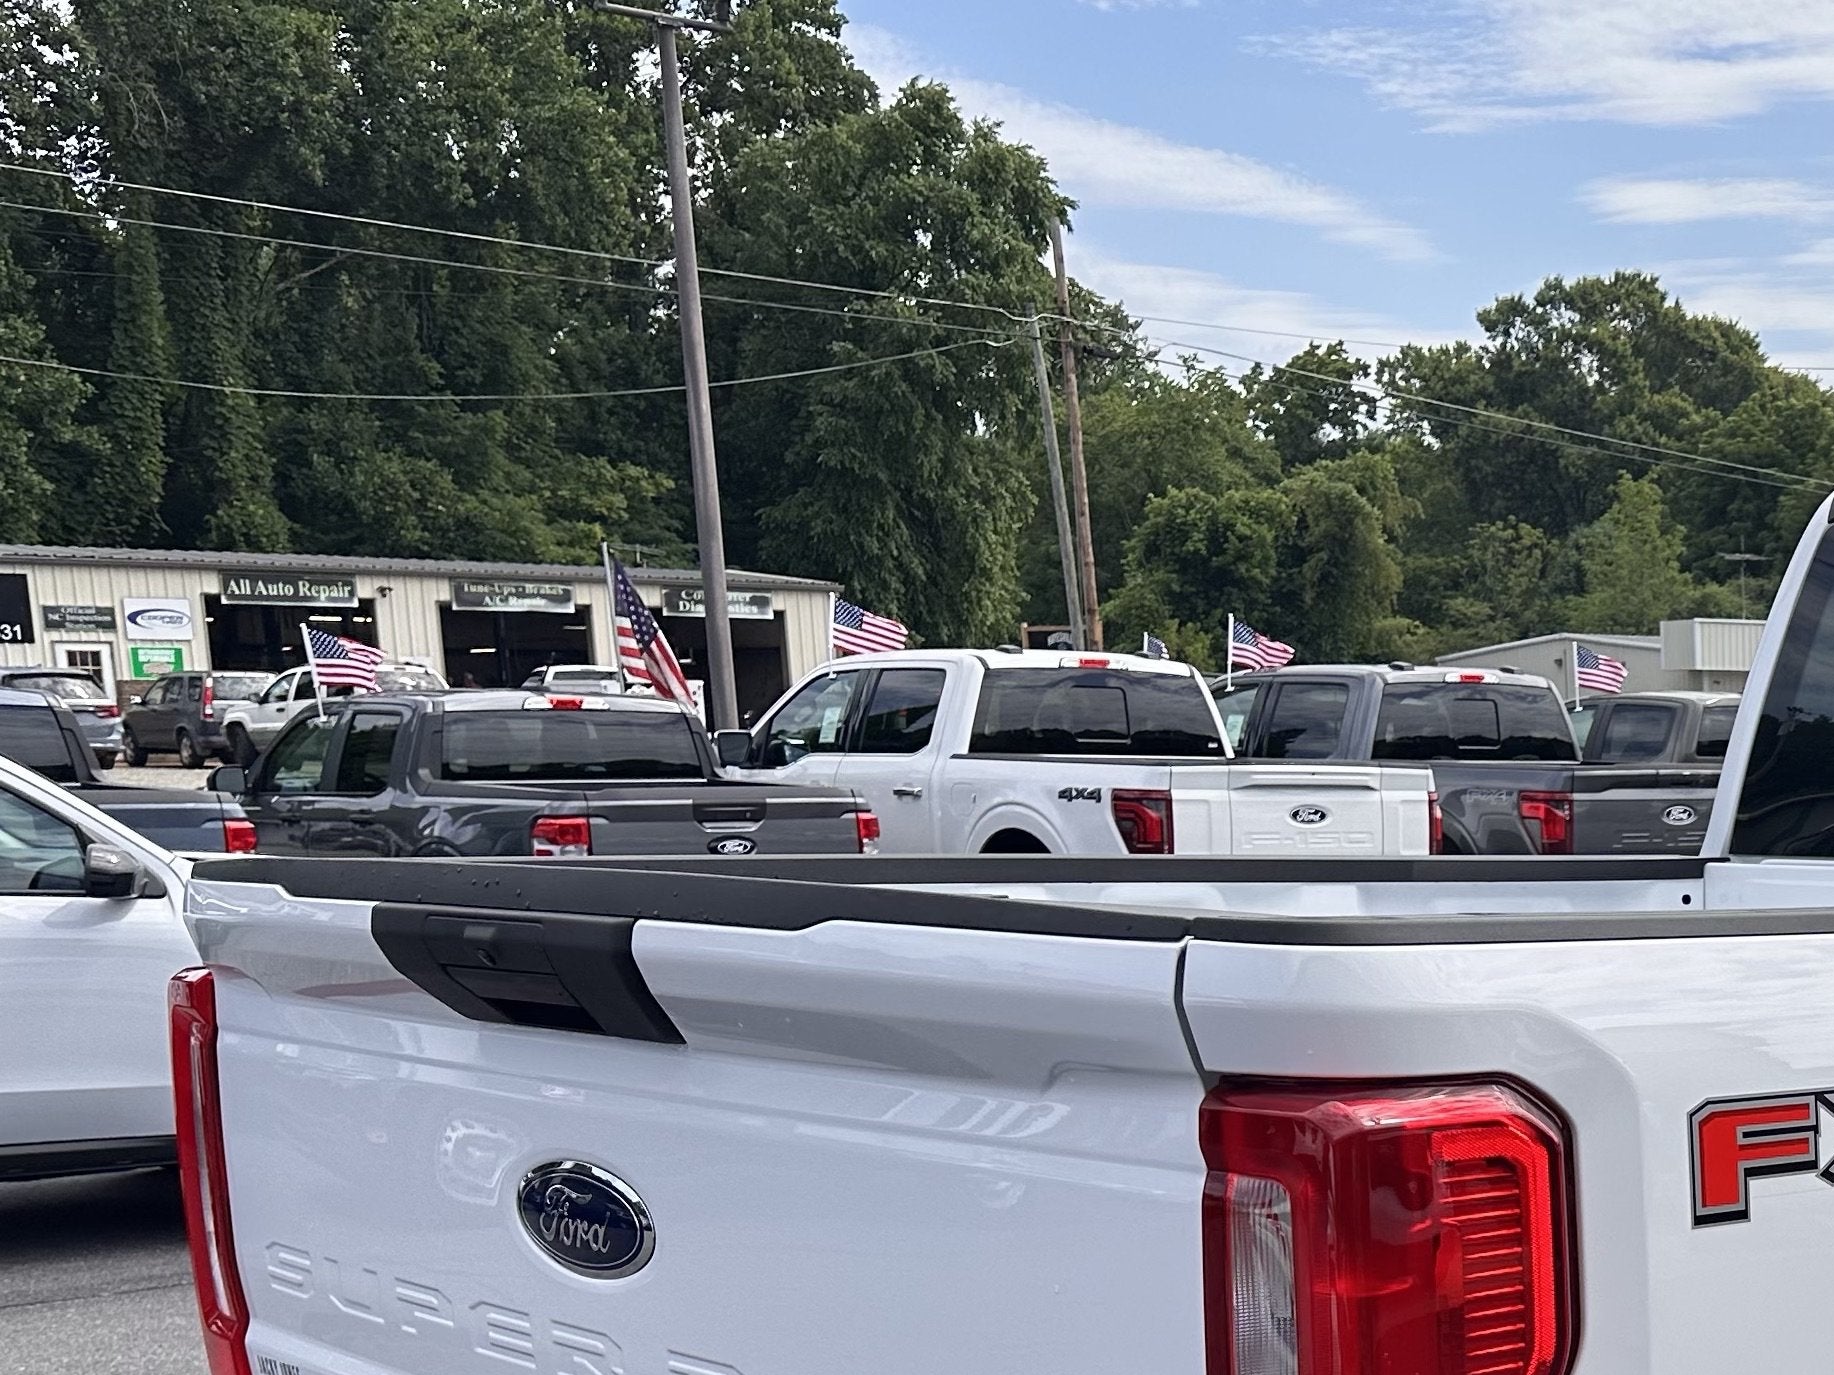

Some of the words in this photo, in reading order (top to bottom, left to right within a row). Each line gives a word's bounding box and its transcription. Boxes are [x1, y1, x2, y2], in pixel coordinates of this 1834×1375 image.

[226, 578, 251, 595] All
[255, 580, 294, 597] Auto
[298, 581, 352, 601] Repair
[482, 595, 506, 606] A/C
[0, 624, 22, 641] 31
[1242, 831, 1375, 849] F-150
[540, 1184, 611, 1254] Ford
